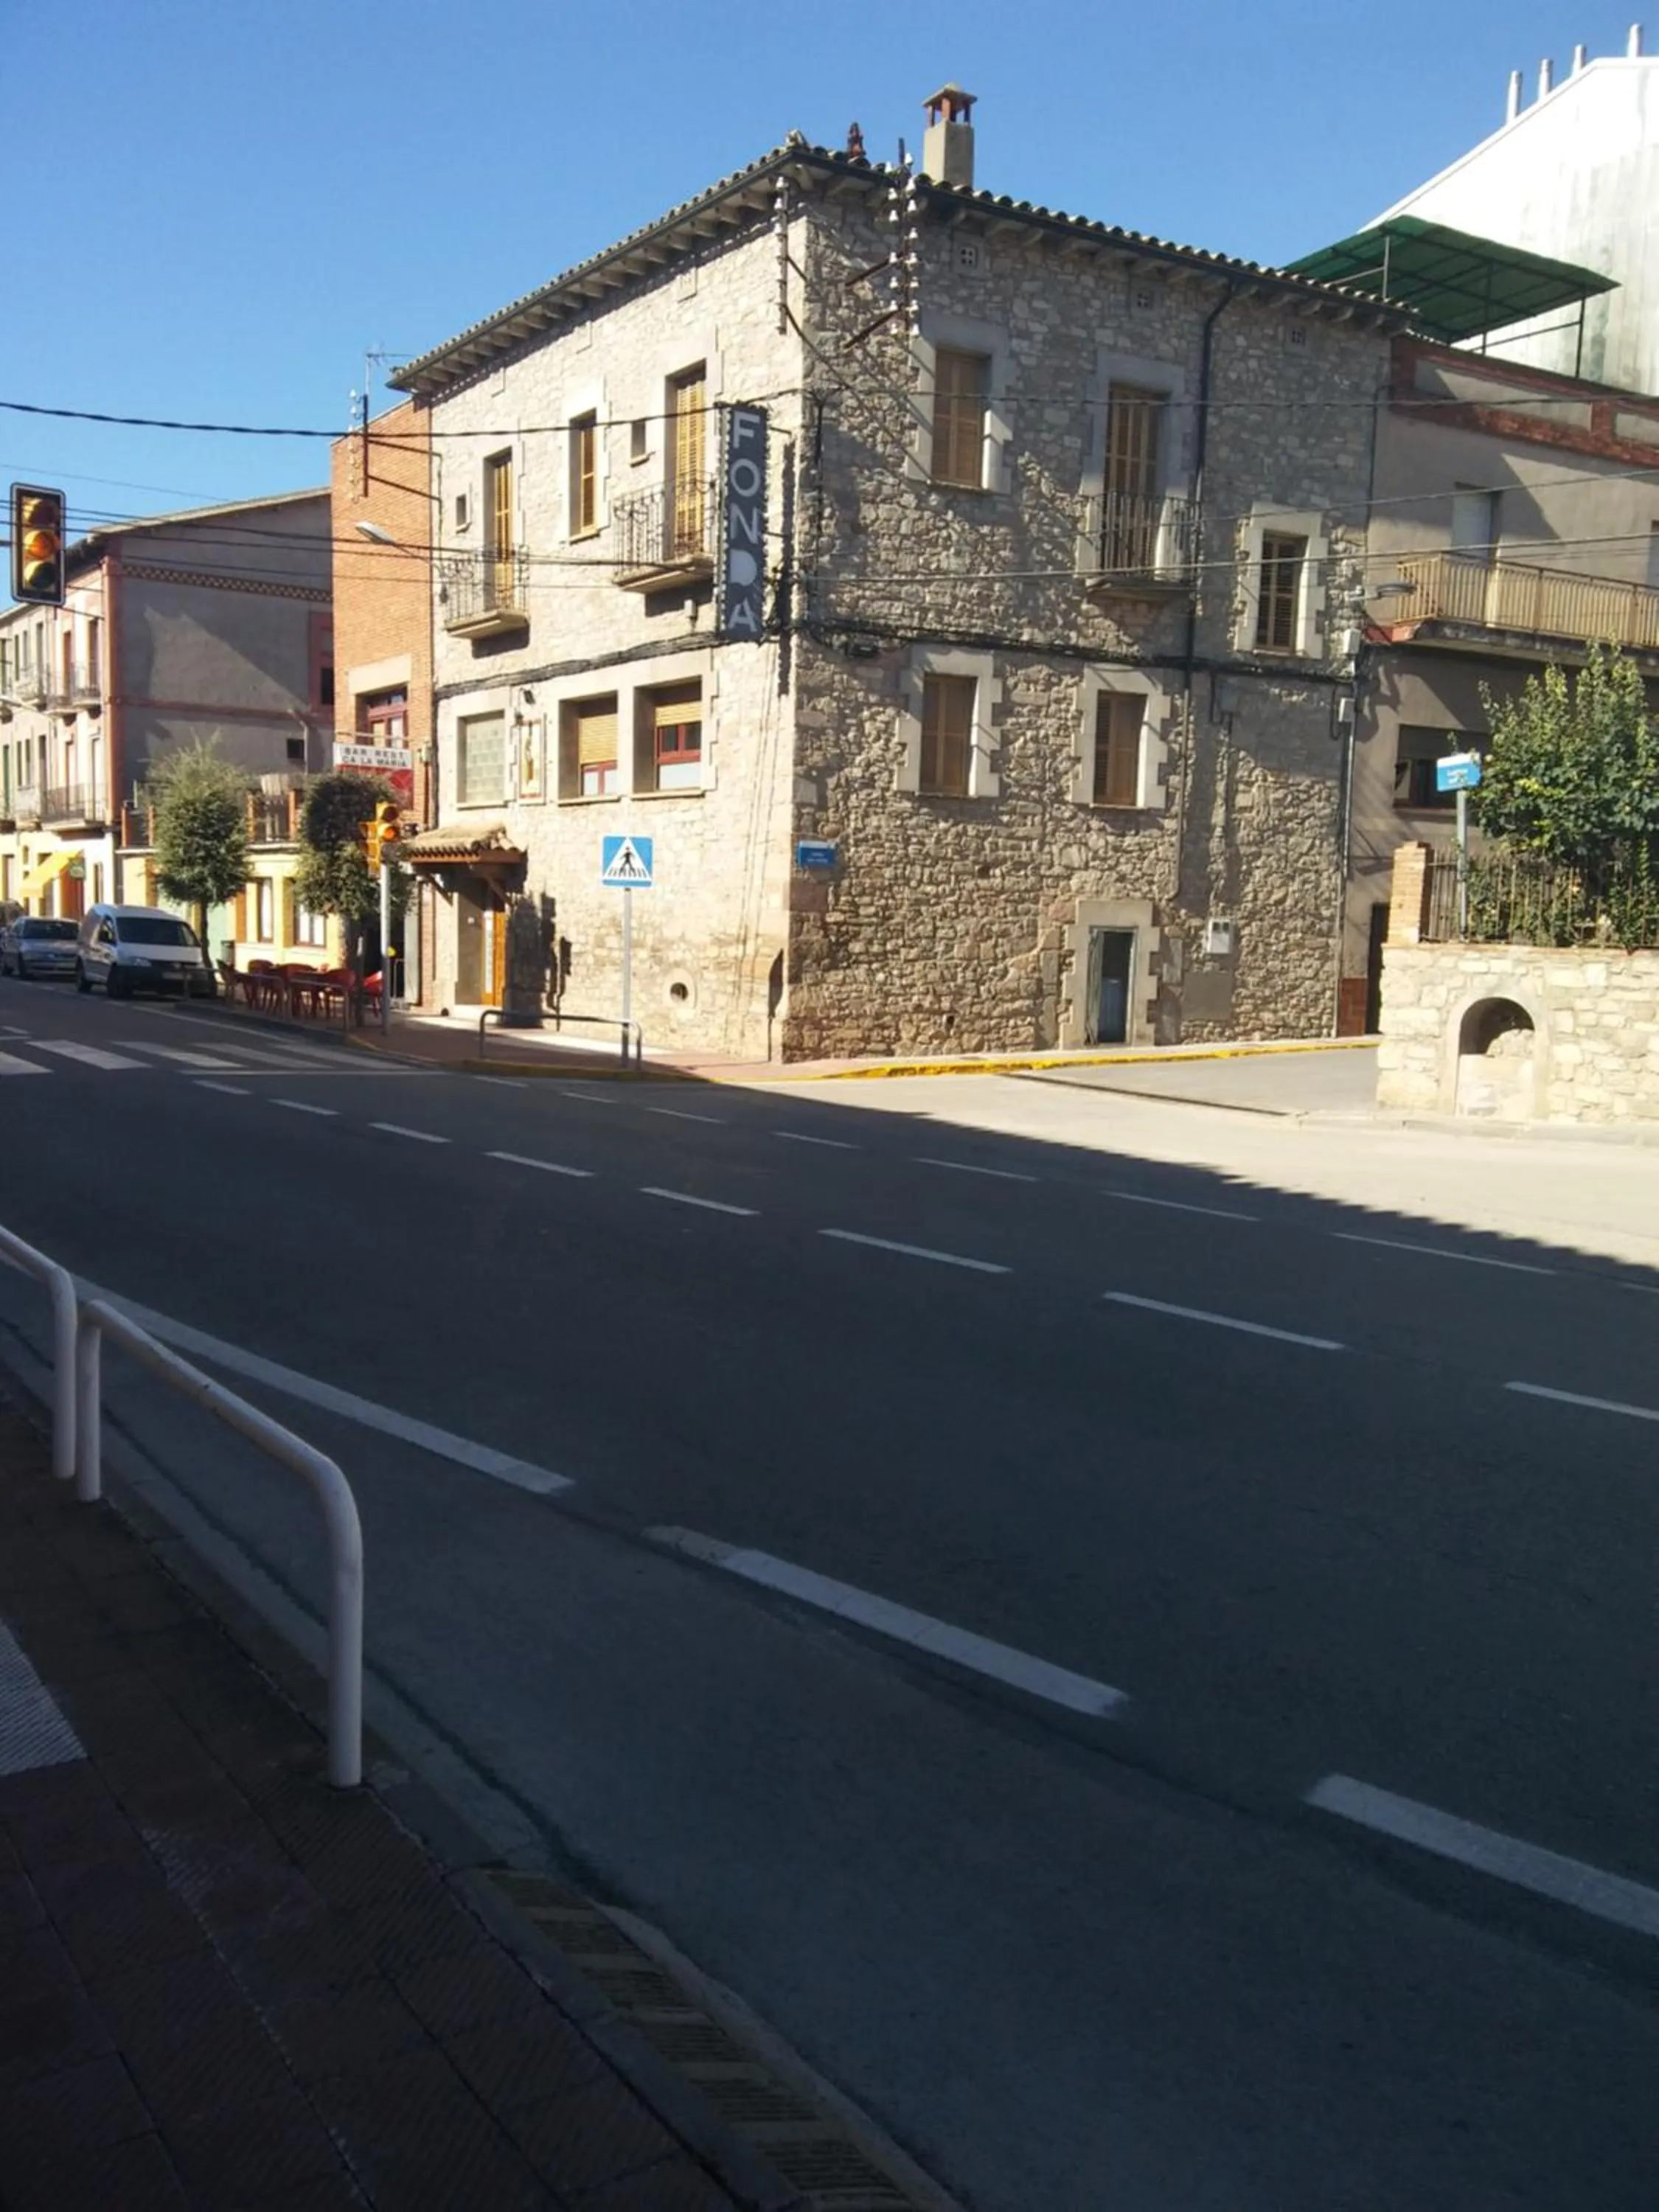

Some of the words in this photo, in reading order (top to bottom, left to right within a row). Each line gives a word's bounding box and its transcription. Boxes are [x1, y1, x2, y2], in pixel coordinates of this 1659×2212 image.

[728, 410, 761, 632] FONDA
[344, 746, 367, 755] BAR
[342, 755, 355, 763] CA
